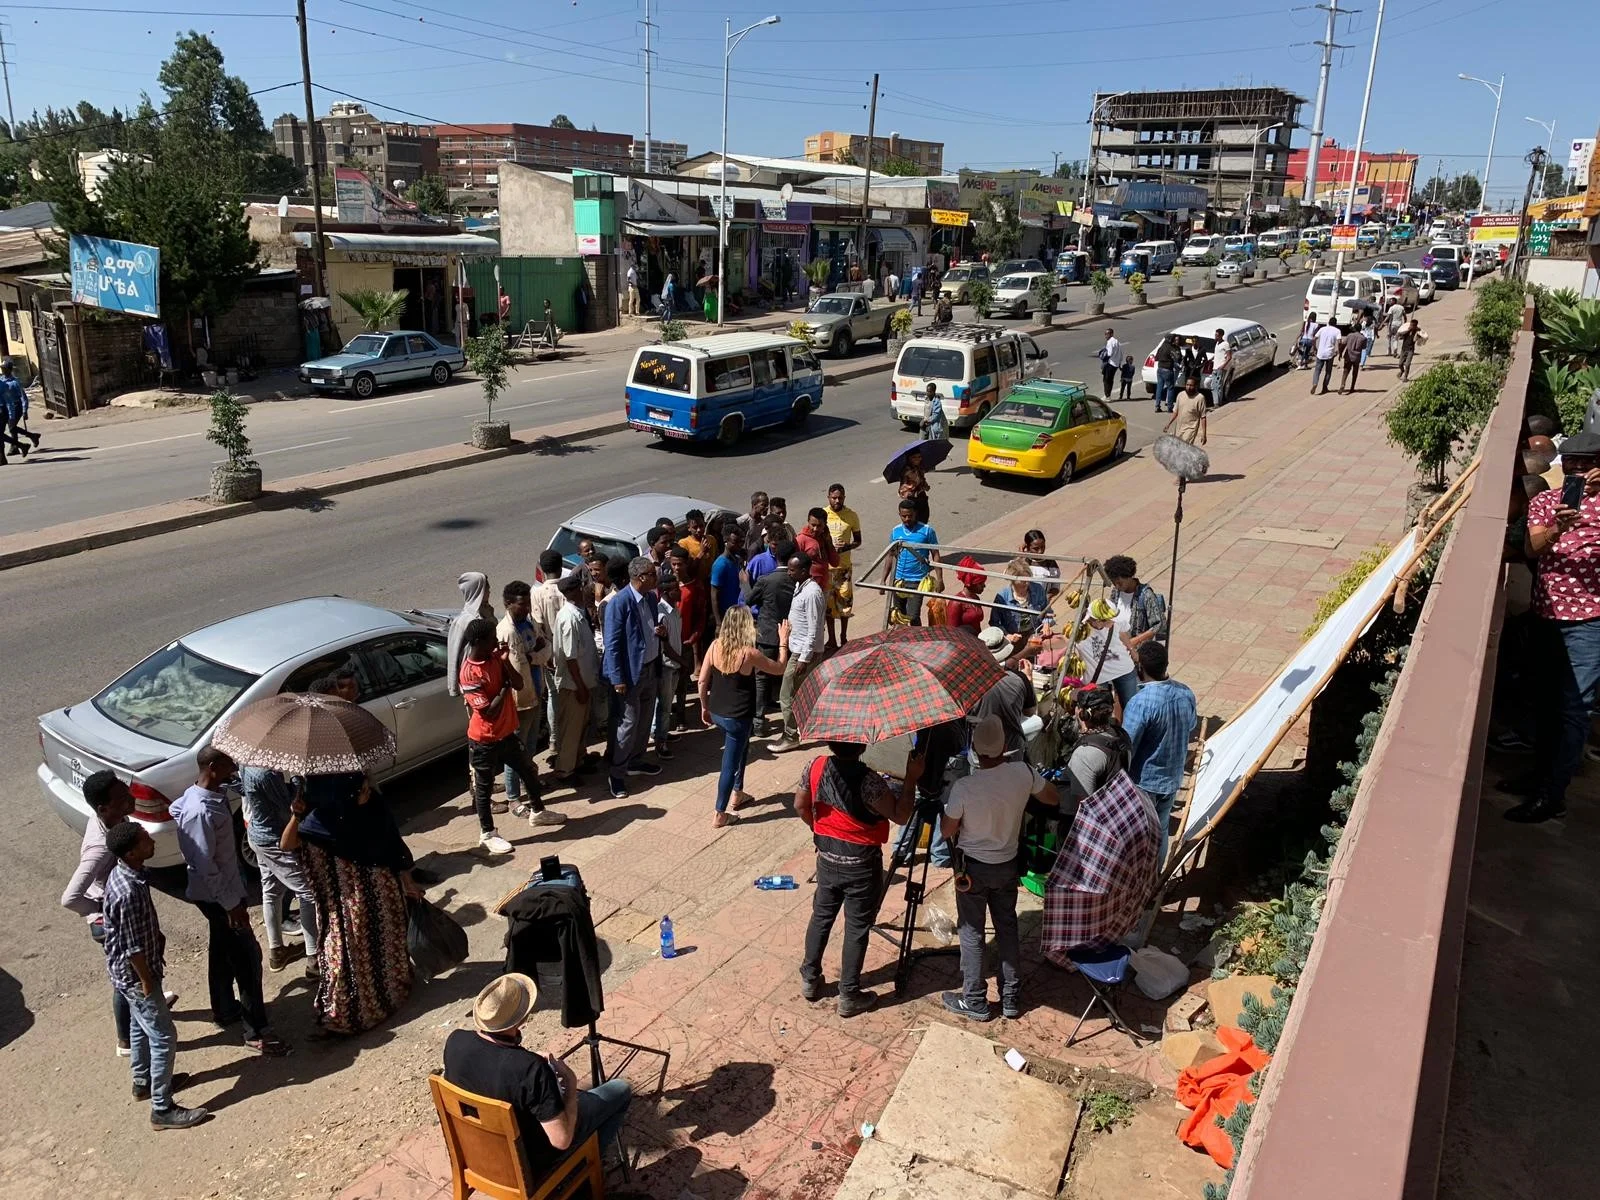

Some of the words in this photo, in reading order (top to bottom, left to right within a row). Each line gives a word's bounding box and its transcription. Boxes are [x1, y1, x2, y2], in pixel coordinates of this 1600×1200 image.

[98, 275, 139, 297] ሆቴል
[640, 358, 658, 370] Never
[653, 364, 667, 379] give
[665, 372, 675, 383] up
